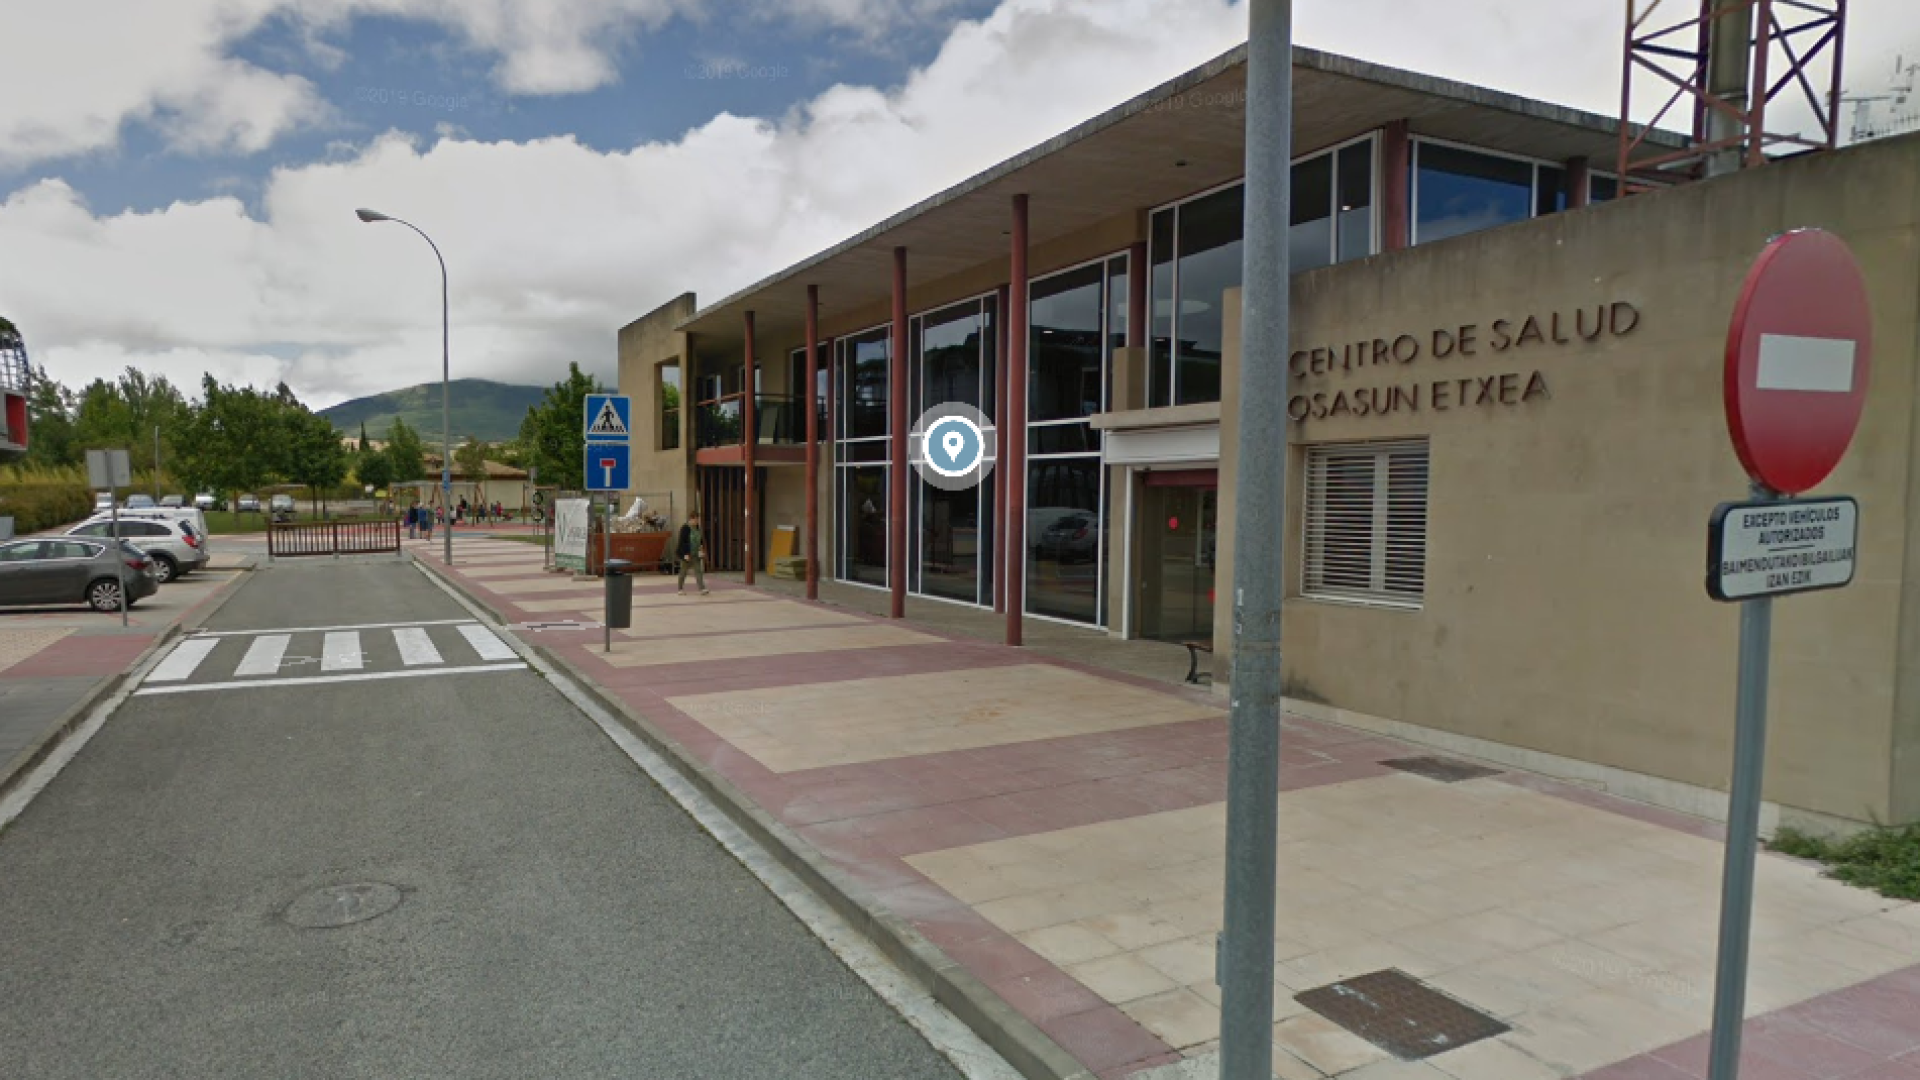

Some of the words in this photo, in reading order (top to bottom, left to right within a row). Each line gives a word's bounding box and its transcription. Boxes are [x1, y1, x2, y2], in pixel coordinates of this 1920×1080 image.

[1288, 334, 1419, 380] CENTRO
[1432, 324, 1477, 360] DE
[1490, 302, 1640, 352] SALUD
[1288, 383, 1418, 422] OSASUN
[1431, 370, 1549, 411] ETXEA
[1743, 511, 1786, 529] EXCEPTO
[1758, 526, 1825, 544] AUTORIZADOS
